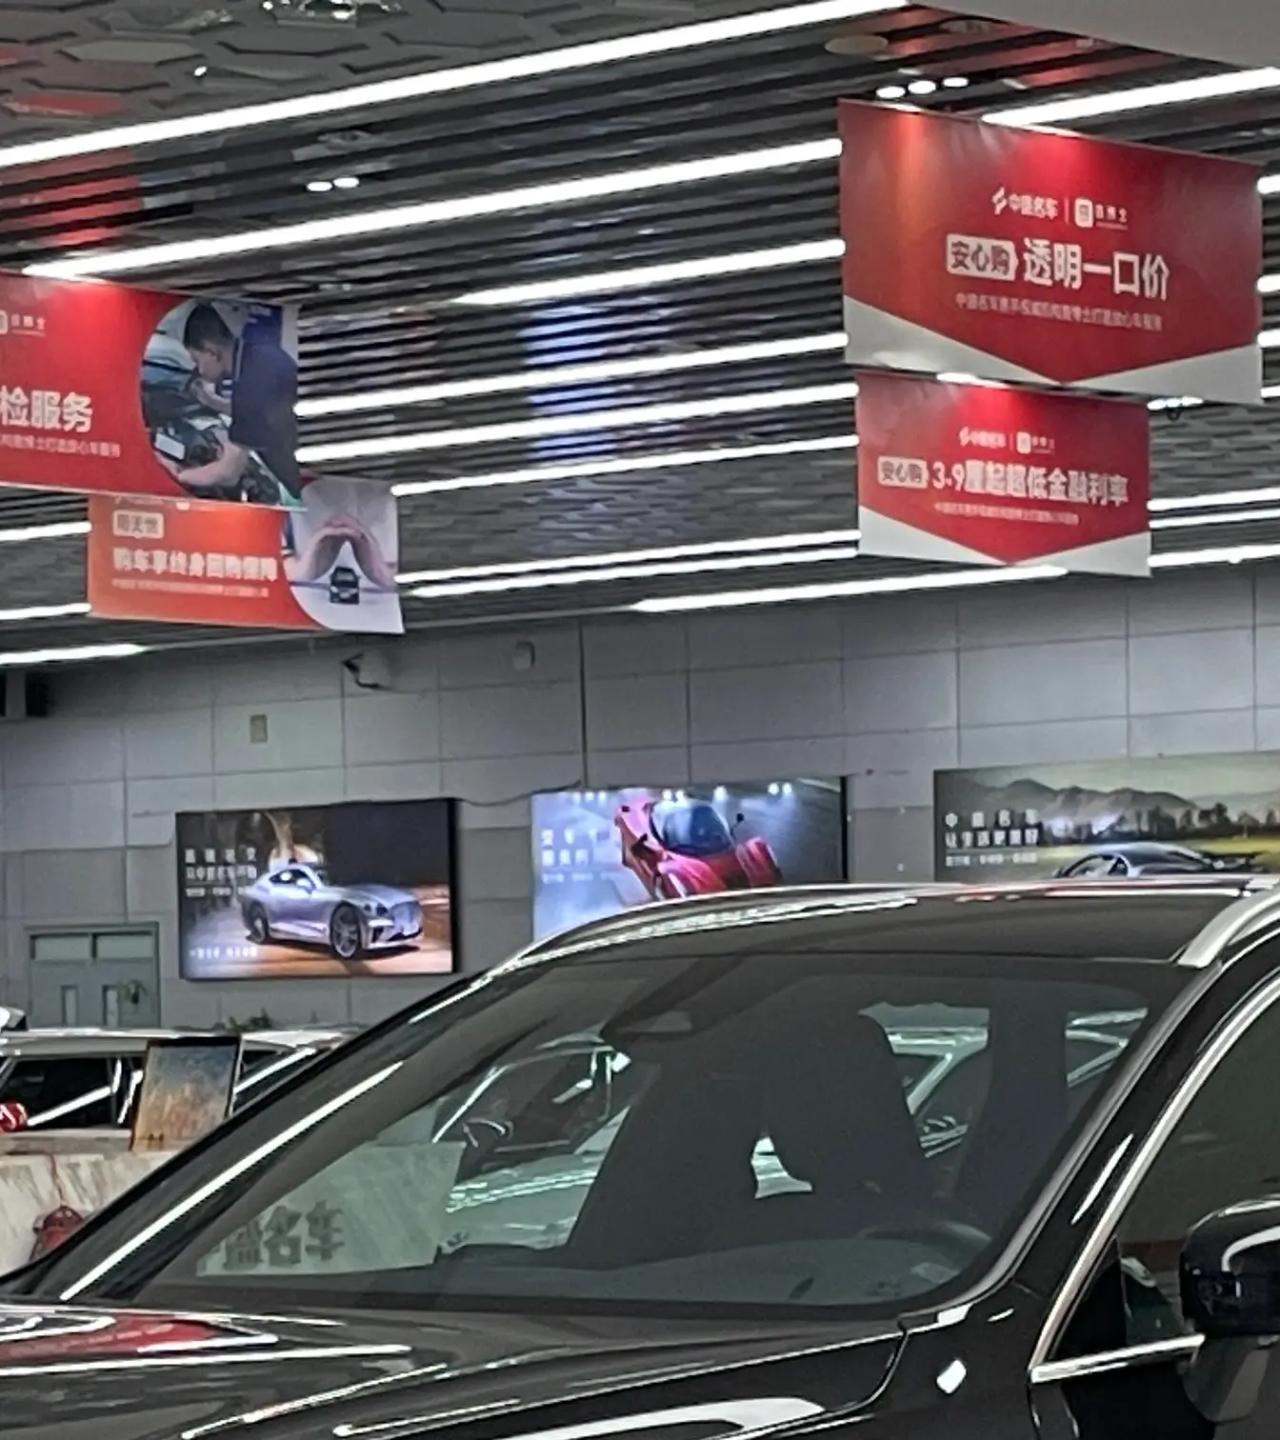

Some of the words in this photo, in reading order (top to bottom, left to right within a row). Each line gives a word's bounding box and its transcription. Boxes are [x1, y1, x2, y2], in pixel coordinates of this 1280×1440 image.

[951, 240, 1012, 277] 安心购
[1024, 238, 1169, 302] 透明一口价
[198, 1200, 345, 1271] 盛名车
